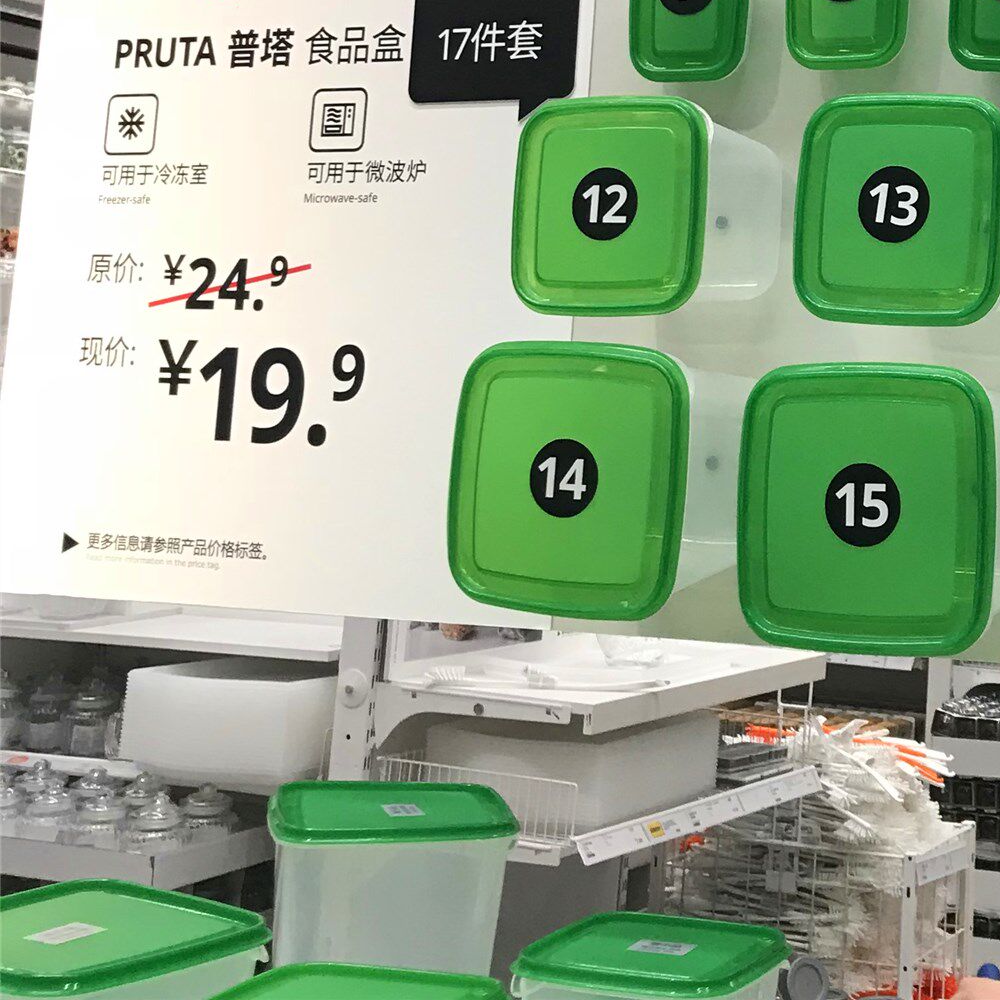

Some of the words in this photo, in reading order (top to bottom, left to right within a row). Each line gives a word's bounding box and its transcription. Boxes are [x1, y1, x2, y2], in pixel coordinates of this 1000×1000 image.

[114, 36, 216, 69] PRUTA
[227, 28, 295, 69] 普塔
[306, 23, 407, 66] 食品盒
[438, 20, 543, 63] 17件套
[102, 163, 209, 186] 可用于冷冻室
[307, 159, 427, 184] 可用于微波炉
[98, 193, 151, 205] Freezer-safe
[303, 192, 378, 204] Microwave-safe
[582, 184, 628, 224] 12
[869, 182, 919, 227] 13
[538, 456, 587, 500] 14
[835, 482, 889, 528] 15
